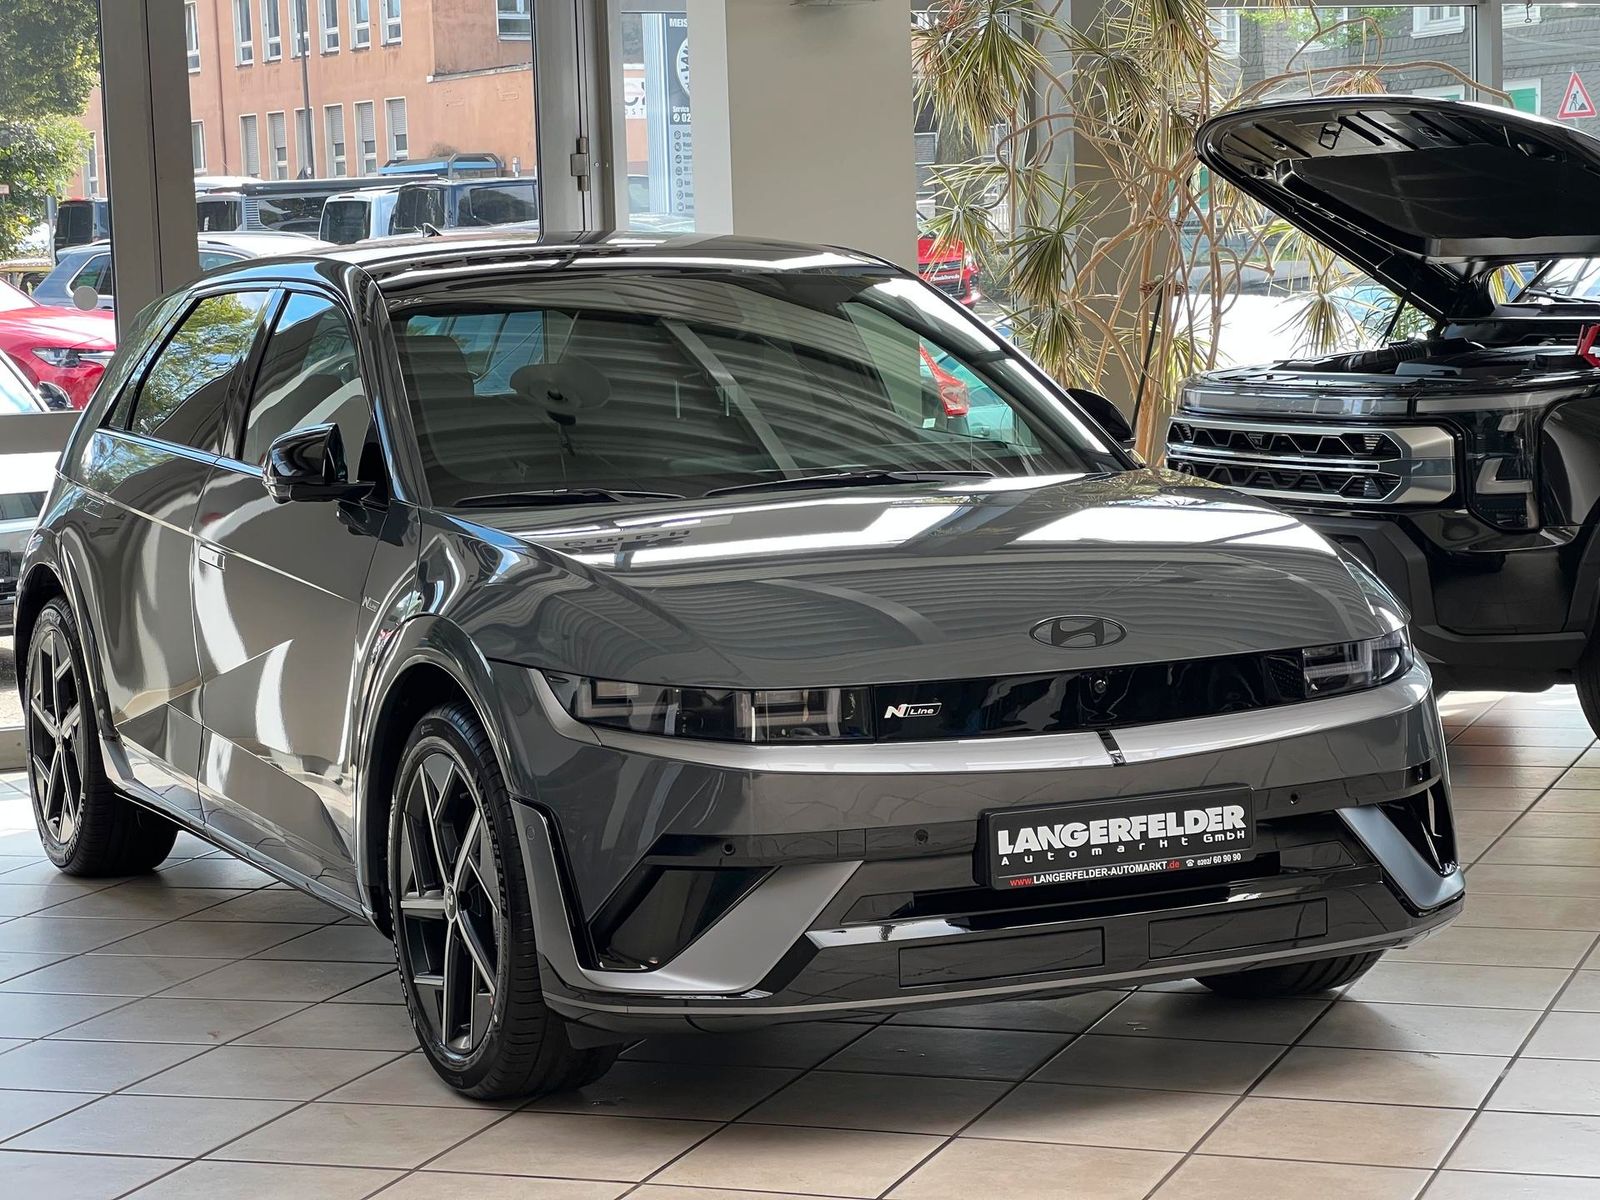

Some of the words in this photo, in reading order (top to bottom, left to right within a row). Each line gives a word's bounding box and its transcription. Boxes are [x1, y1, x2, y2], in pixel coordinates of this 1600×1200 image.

[997, 805, 1246, 855] LANGERFELDER
[1203, 830, 1246, 843] GmbH
[1009, 859, 1180, 887] www.LANGERFELDER-AUTOMARKT.de
[1212, 855, 1222, 864] 60
[1222, 854, 1232, 863] 90
[1232, 852, 1242, 862] 90
